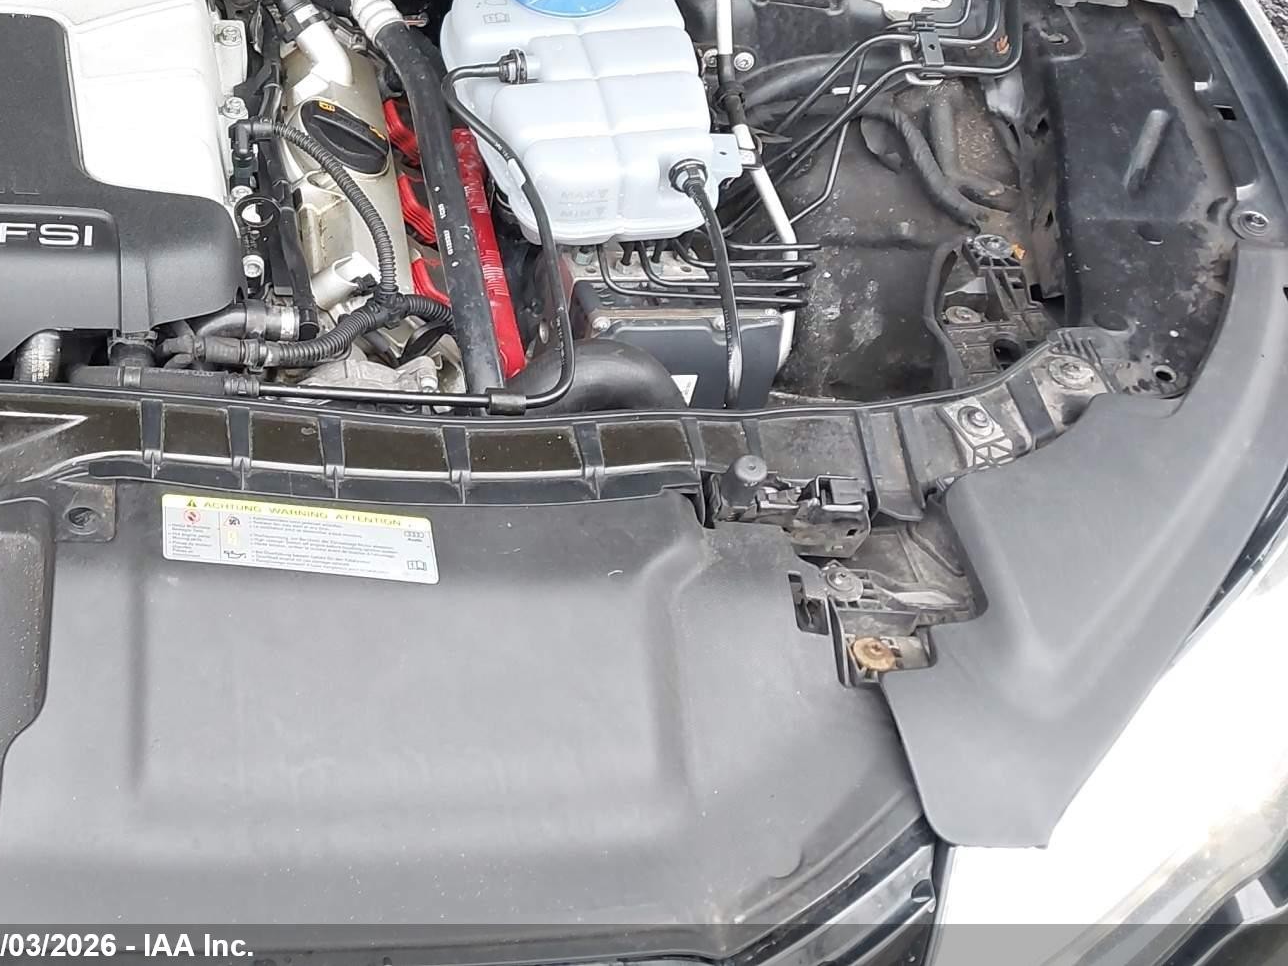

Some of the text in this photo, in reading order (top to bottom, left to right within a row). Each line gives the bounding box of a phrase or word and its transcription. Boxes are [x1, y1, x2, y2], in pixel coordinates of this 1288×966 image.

[203, 501, 263, 513] ACHTUNG
[268, 506, 330, 520] WARNING
[335, 513, 402, 527] ATTENTION
